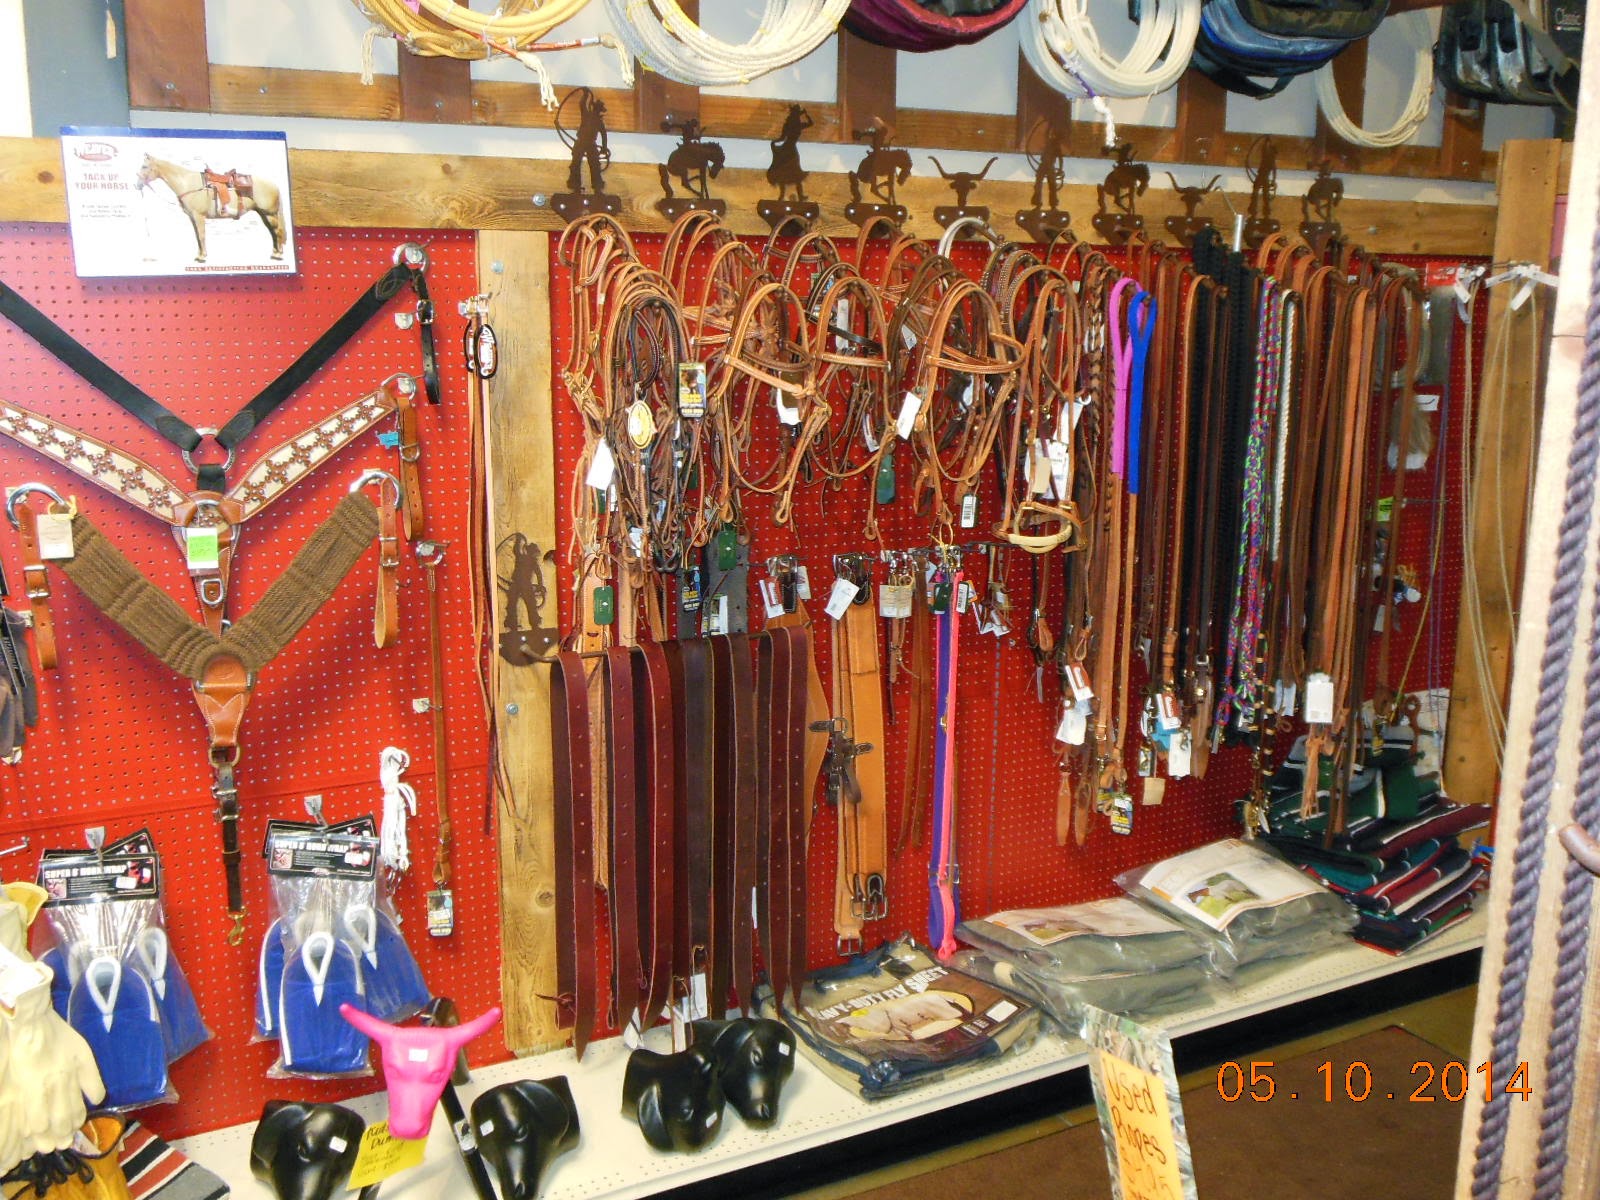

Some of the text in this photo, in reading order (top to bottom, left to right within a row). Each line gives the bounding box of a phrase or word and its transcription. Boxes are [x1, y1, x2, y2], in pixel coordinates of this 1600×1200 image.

[83, 172, 106, 181] TACK
[75, 181, 129, 191] YOUR HORSE
[1102, 1056, 1158, 1118] Used
